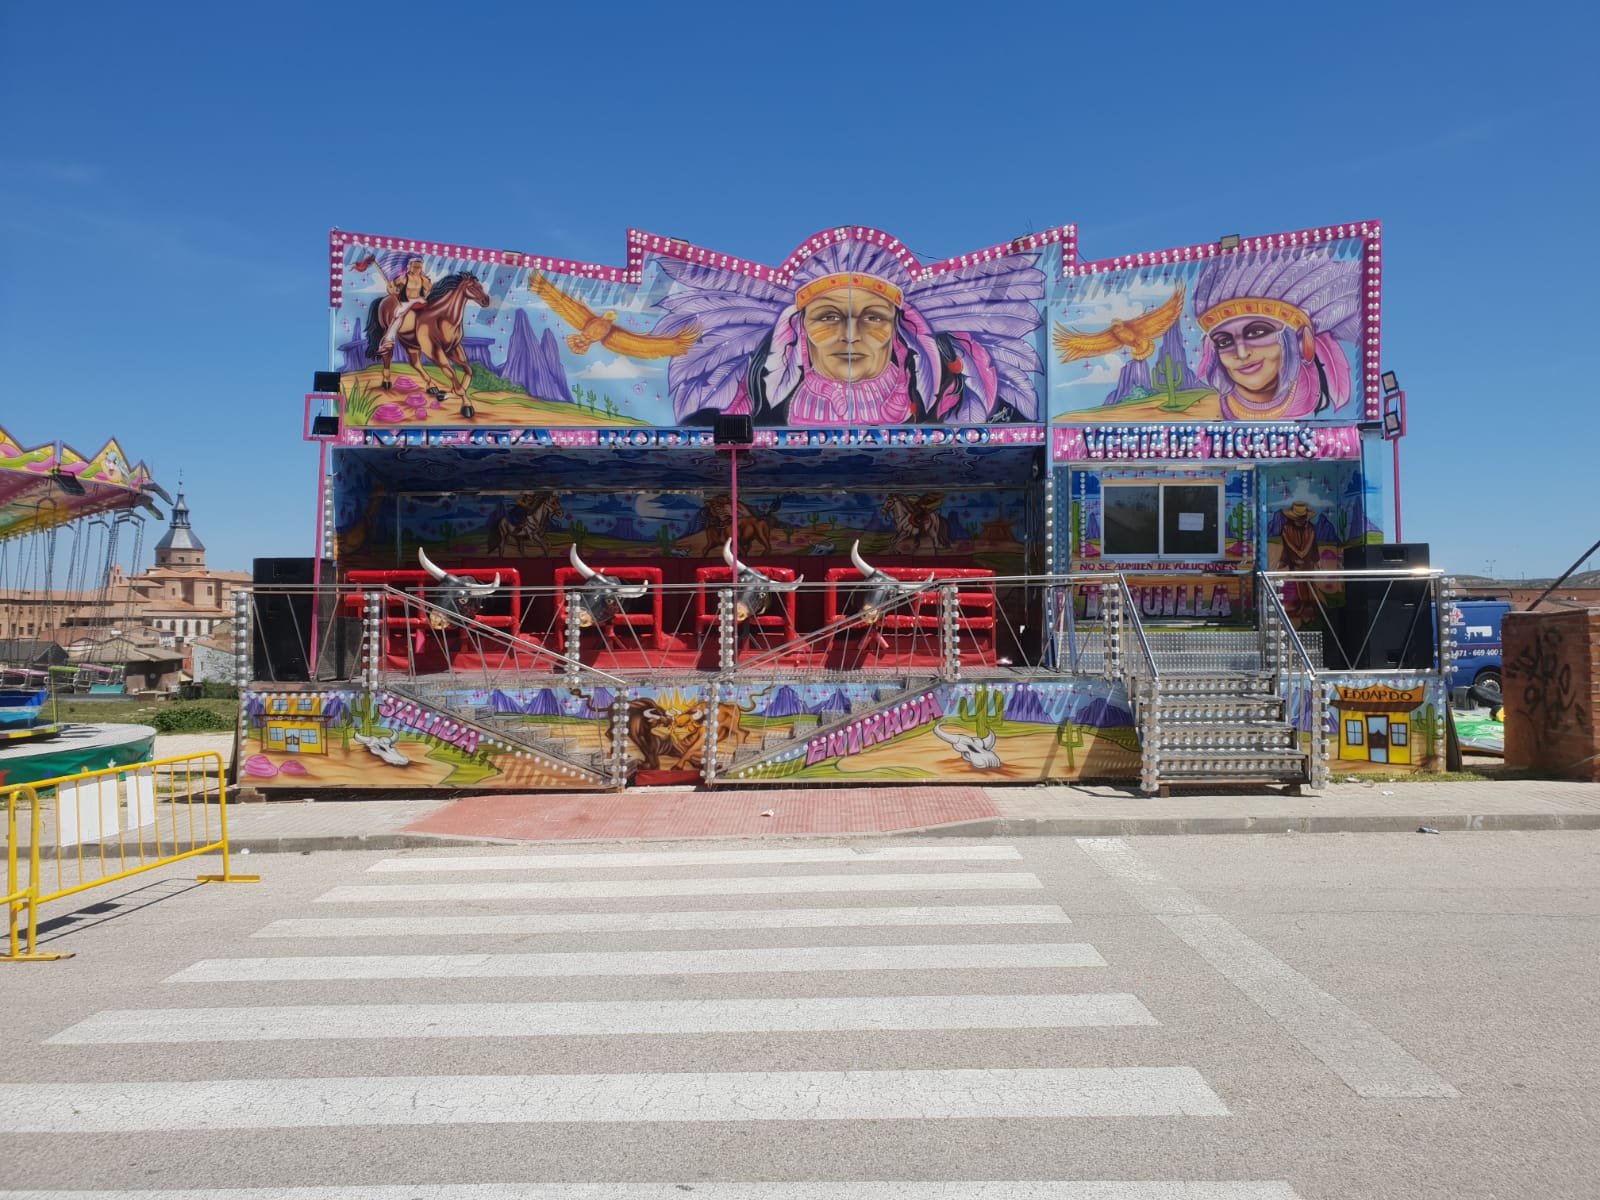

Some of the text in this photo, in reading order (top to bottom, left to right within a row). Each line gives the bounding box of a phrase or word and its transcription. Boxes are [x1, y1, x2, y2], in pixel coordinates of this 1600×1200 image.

[364, 427, 991, 447] MEGA RODE EDUARDO
[1083, 425, 1317, 459] VENTA DE TICKETS
[1080, 563, 1096, 571] NO
[1099, 562, 1112, 571] SE
[1343, 689, 1413, 701] EDUARDO
[378, 696, 481, 754] SALIDA
[805, 692, 944, 767] ENTRADA
